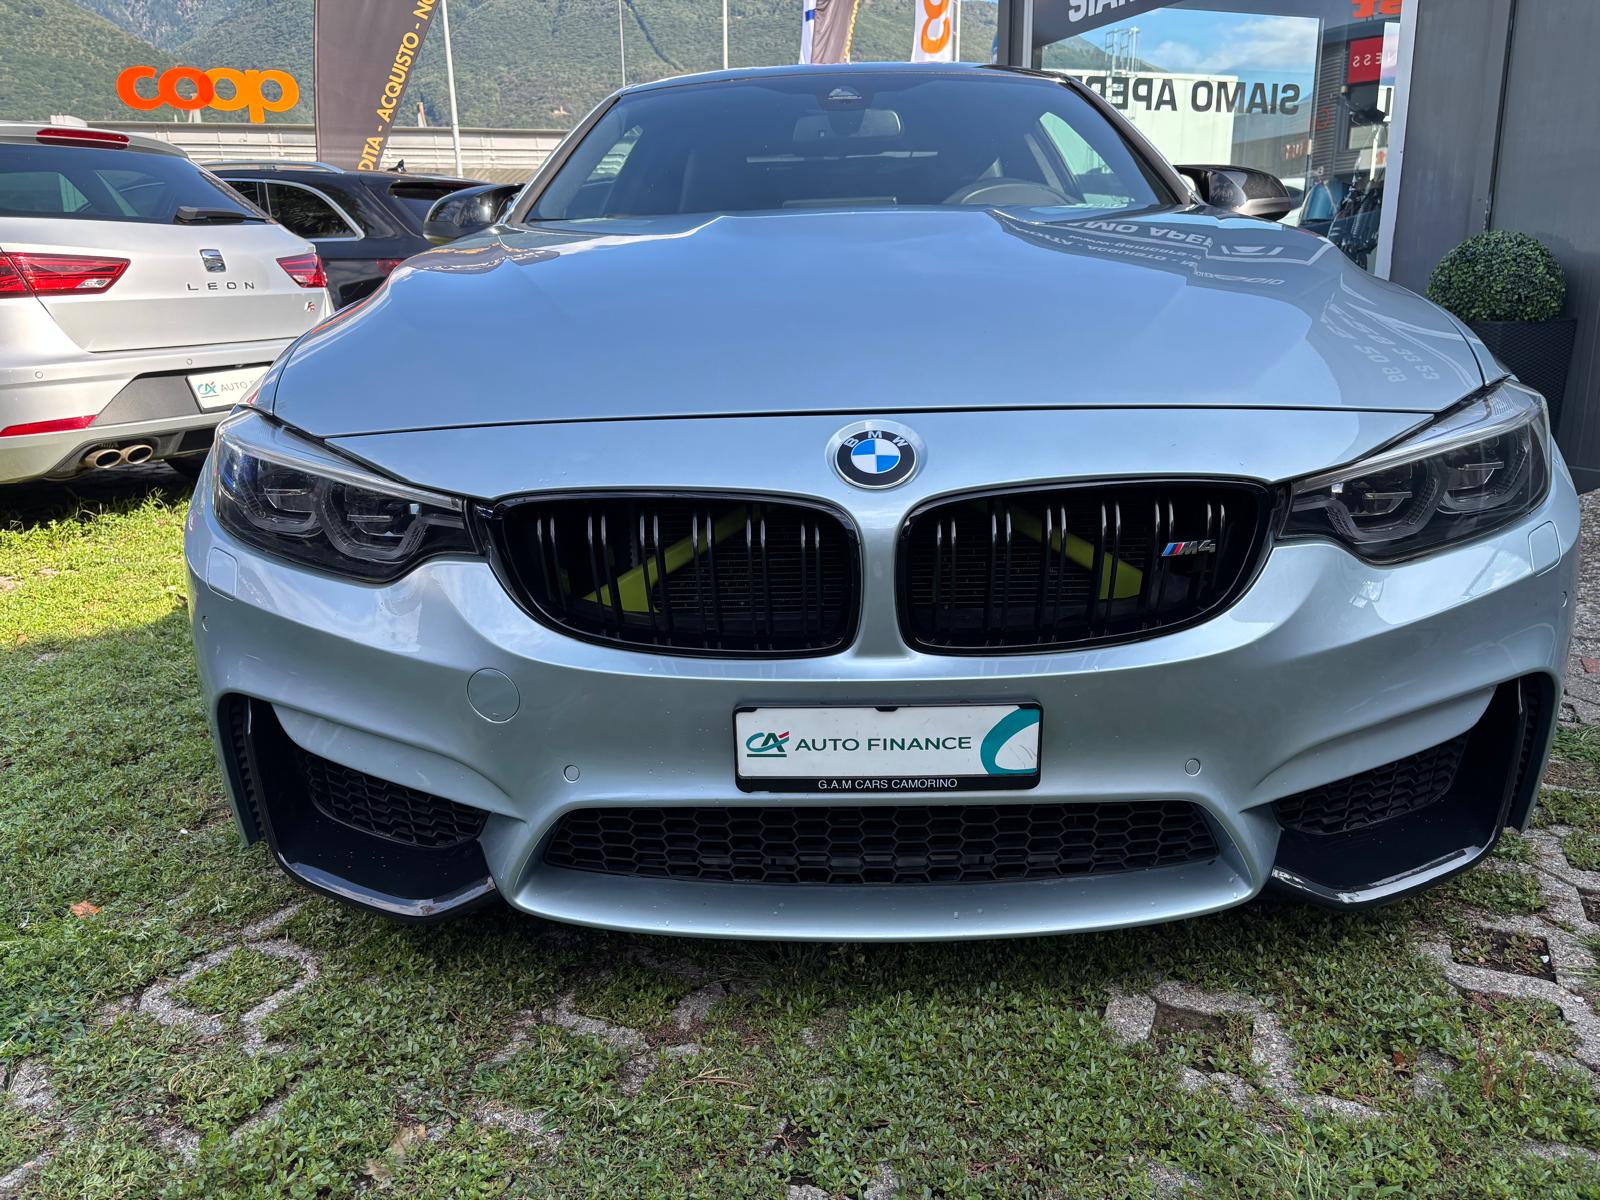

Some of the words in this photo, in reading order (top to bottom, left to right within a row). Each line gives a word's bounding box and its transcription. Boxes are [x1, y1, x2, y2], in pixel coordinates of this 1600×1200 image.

[376, 31, 420, 123] ACQUISTO
[116, 65, 300, 124] coop
[186, 281, 256, 291] LEON
[220, 381, 249, 393] AUTO
[843, 430, 909, 448] BMW
[794, 737, 861, 752] AUTO
[867, 735, 972, 751] FINANCE
[818, 780, 853, 790] G.A.M
[854, 779, 889, 789] CARS
[891, 778, 959, 789] CAMORINO
